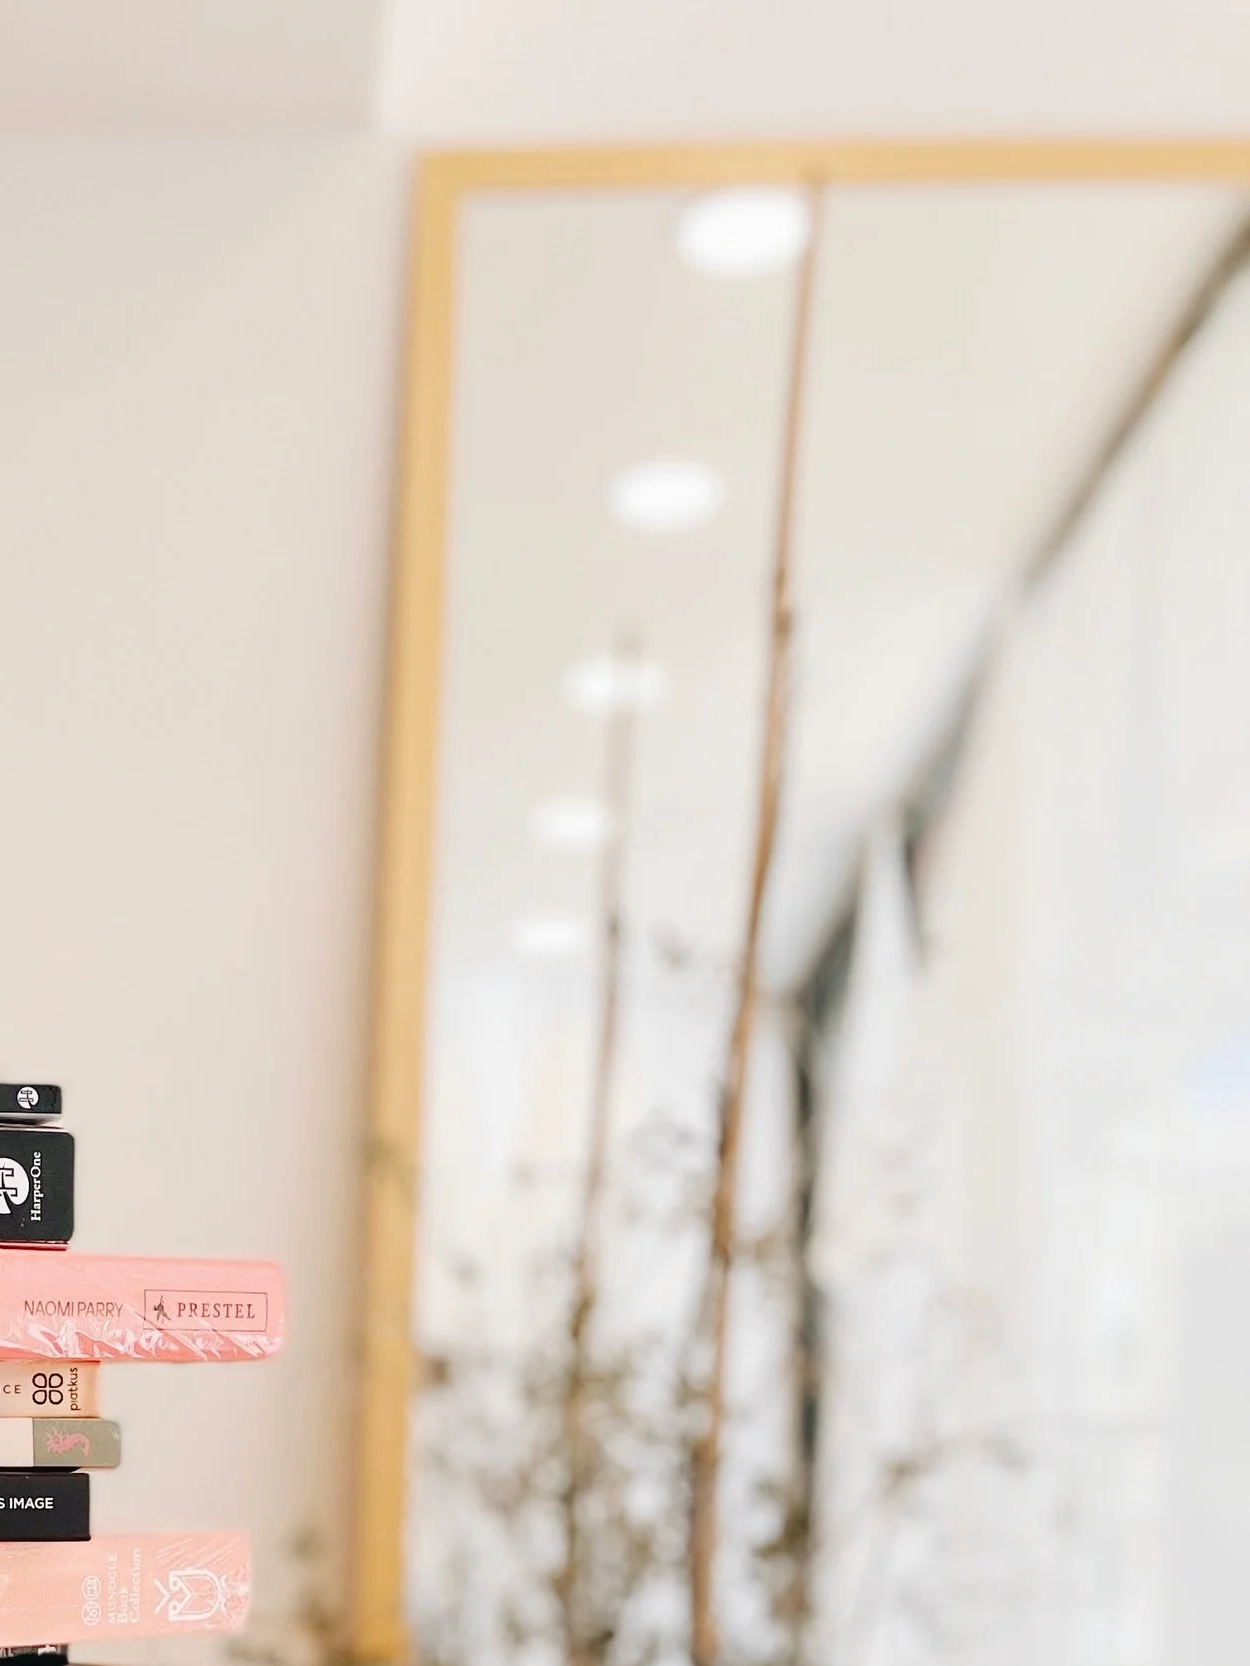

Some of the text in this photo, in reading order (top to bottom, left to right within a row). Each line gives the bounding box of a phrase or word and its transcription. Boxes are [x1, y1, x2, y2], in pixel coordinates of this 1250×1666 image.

[31, 1151, 42, 1222] HarperOne
[177, 1301, 256, 1319] PRESTEL
[69, 1366, 79, 1412] piatkus
[9, 1496, 54, 1510] IMAGE
[118, 1586, 129, 1624] Book
[130, 1548, 142, 1624] Collection
